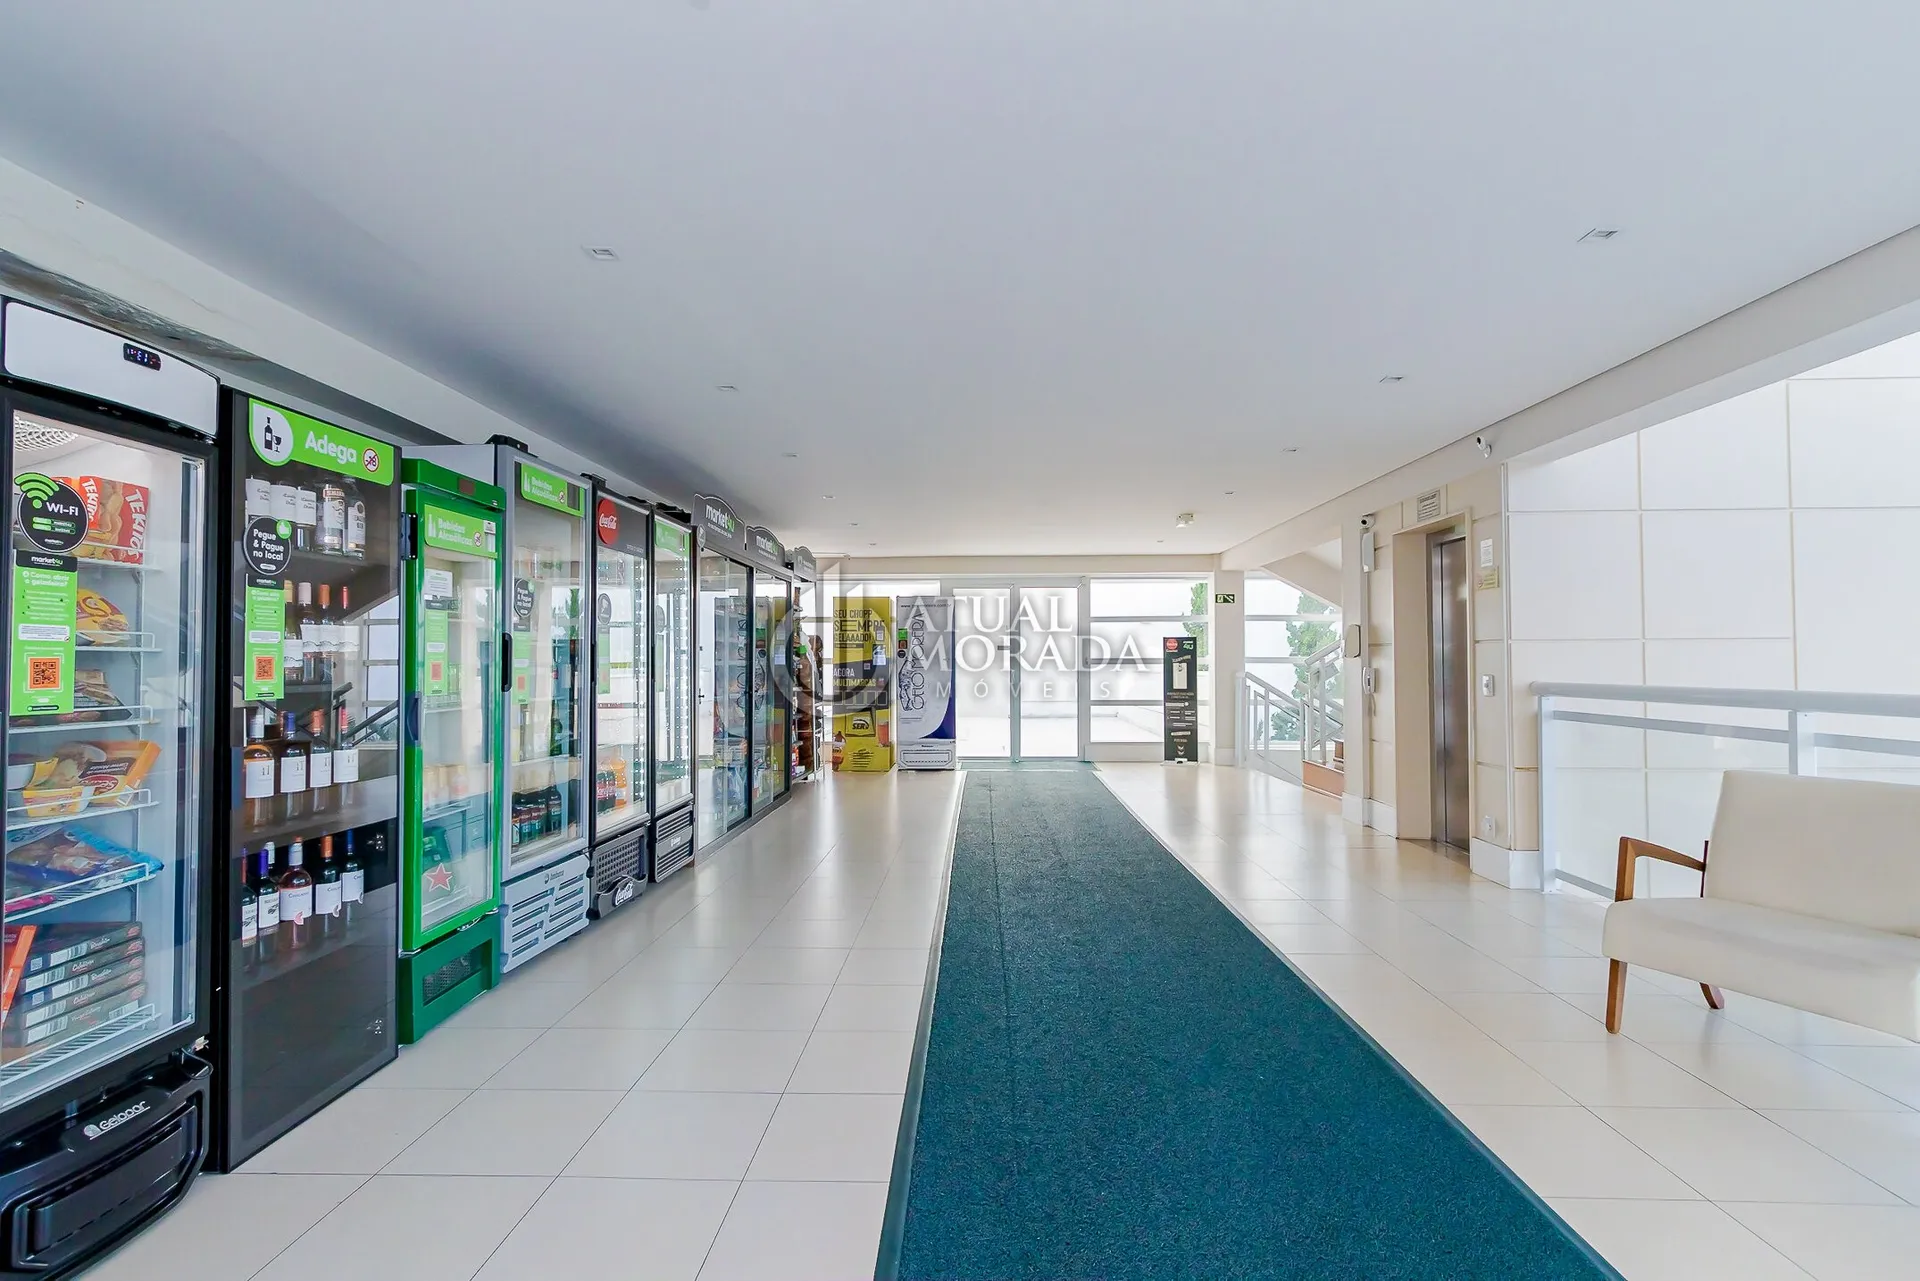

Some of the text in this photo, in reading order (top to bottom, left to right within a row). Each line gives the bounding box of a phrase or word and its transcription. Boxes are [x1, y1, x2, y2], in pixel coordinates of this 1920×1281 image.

[305, 431, 357, 464] Adega
[46, 501, 79, 516] WI-FI
[253, 528, 277, 541] Pegue
[252, 539, 284, 552] & Pague
[252, 550, 284, 561] no local
[834, 609, 872, 618] SEU CHOPP
[833, 668, 855, 677] AGORA
[99, 1101, 146, 1130] Gelopar
